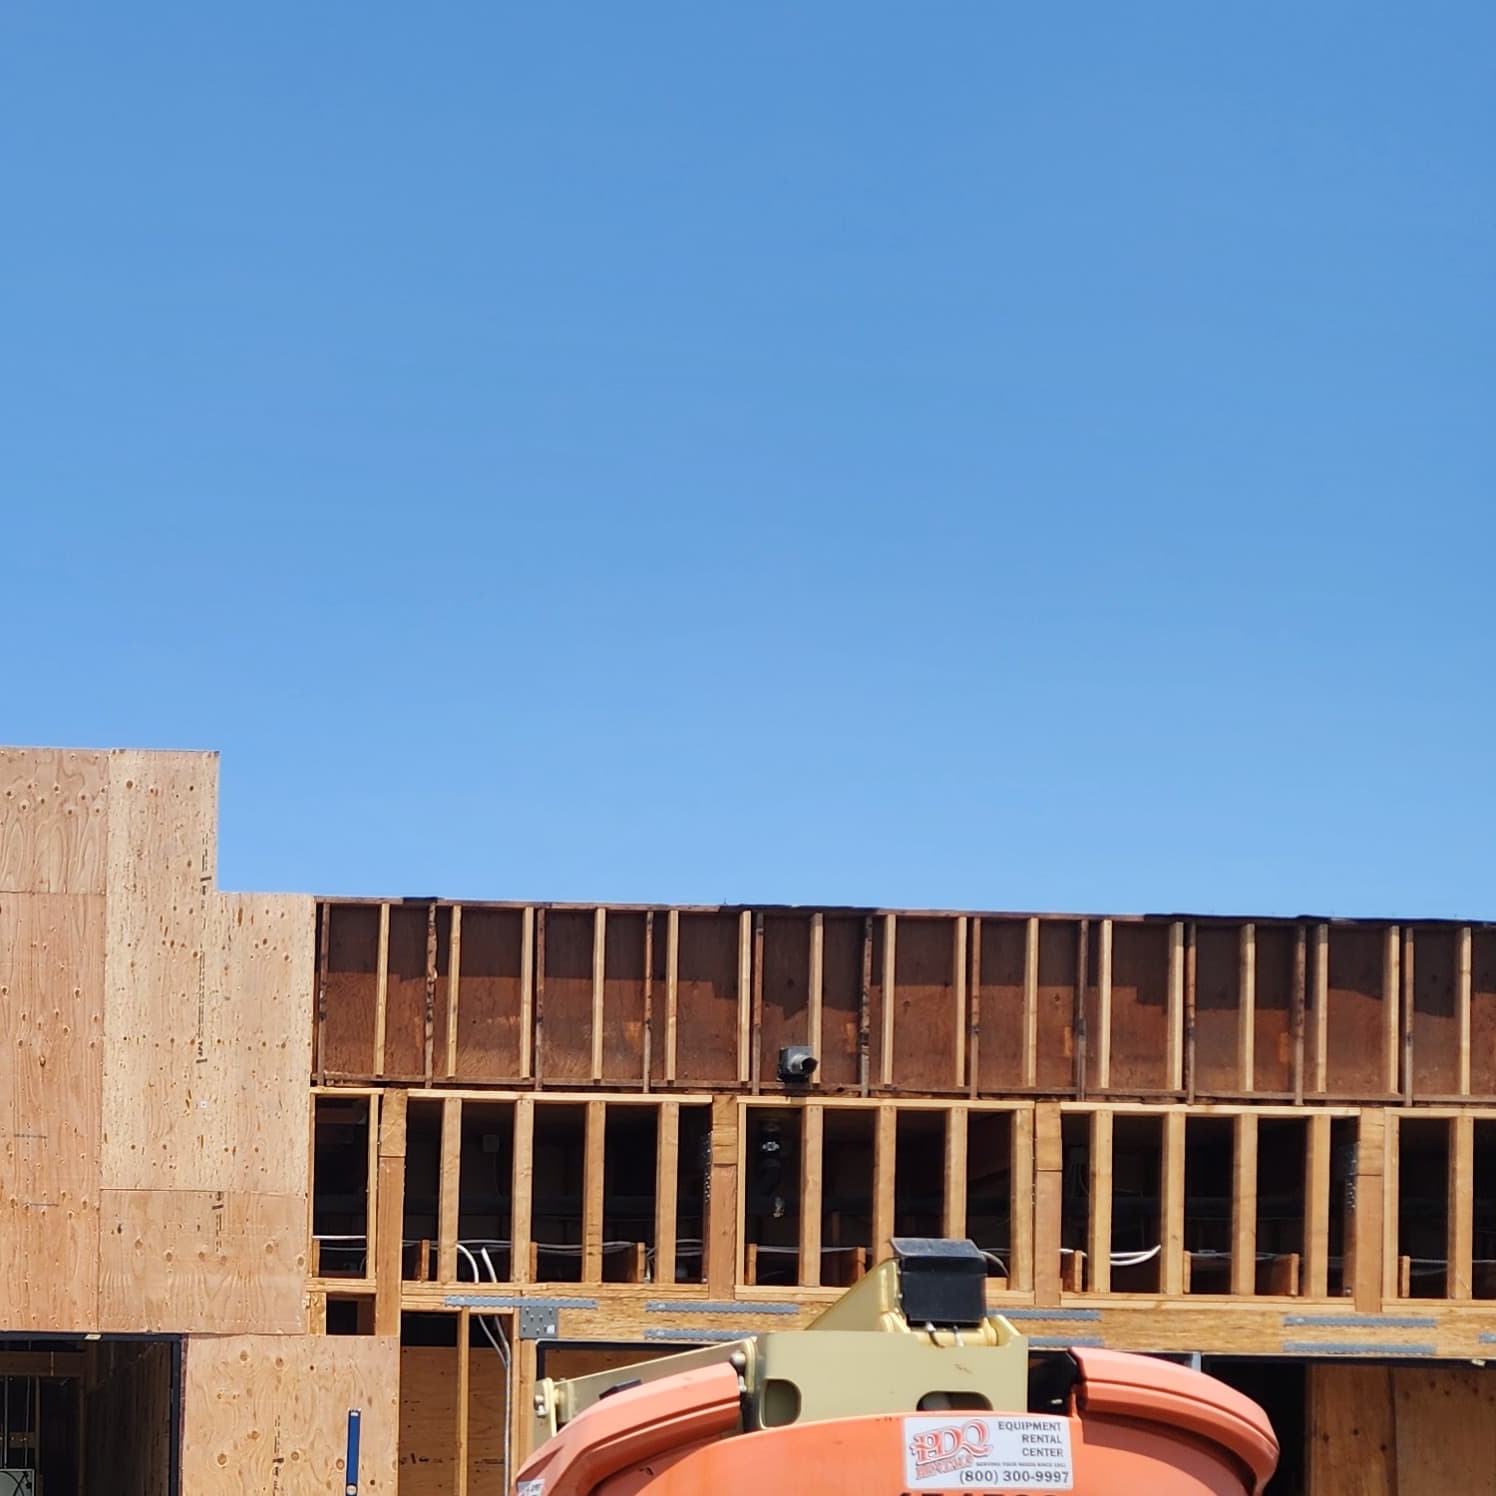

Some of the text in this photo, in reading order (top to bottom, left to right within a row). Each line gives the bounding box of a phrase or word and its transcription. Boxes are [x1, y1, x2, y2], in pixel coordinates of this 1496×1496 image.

[998, 1421, 1062, 1431] EQUIPMENT
[910, 1419, 993, 1465] PDQ
[1022, 1434, 1062, 1444] RENTAL
[1022, 1447, 1064, 1457] CENTER
[959, 1470, 1069, 1485] (800) 300-9997
